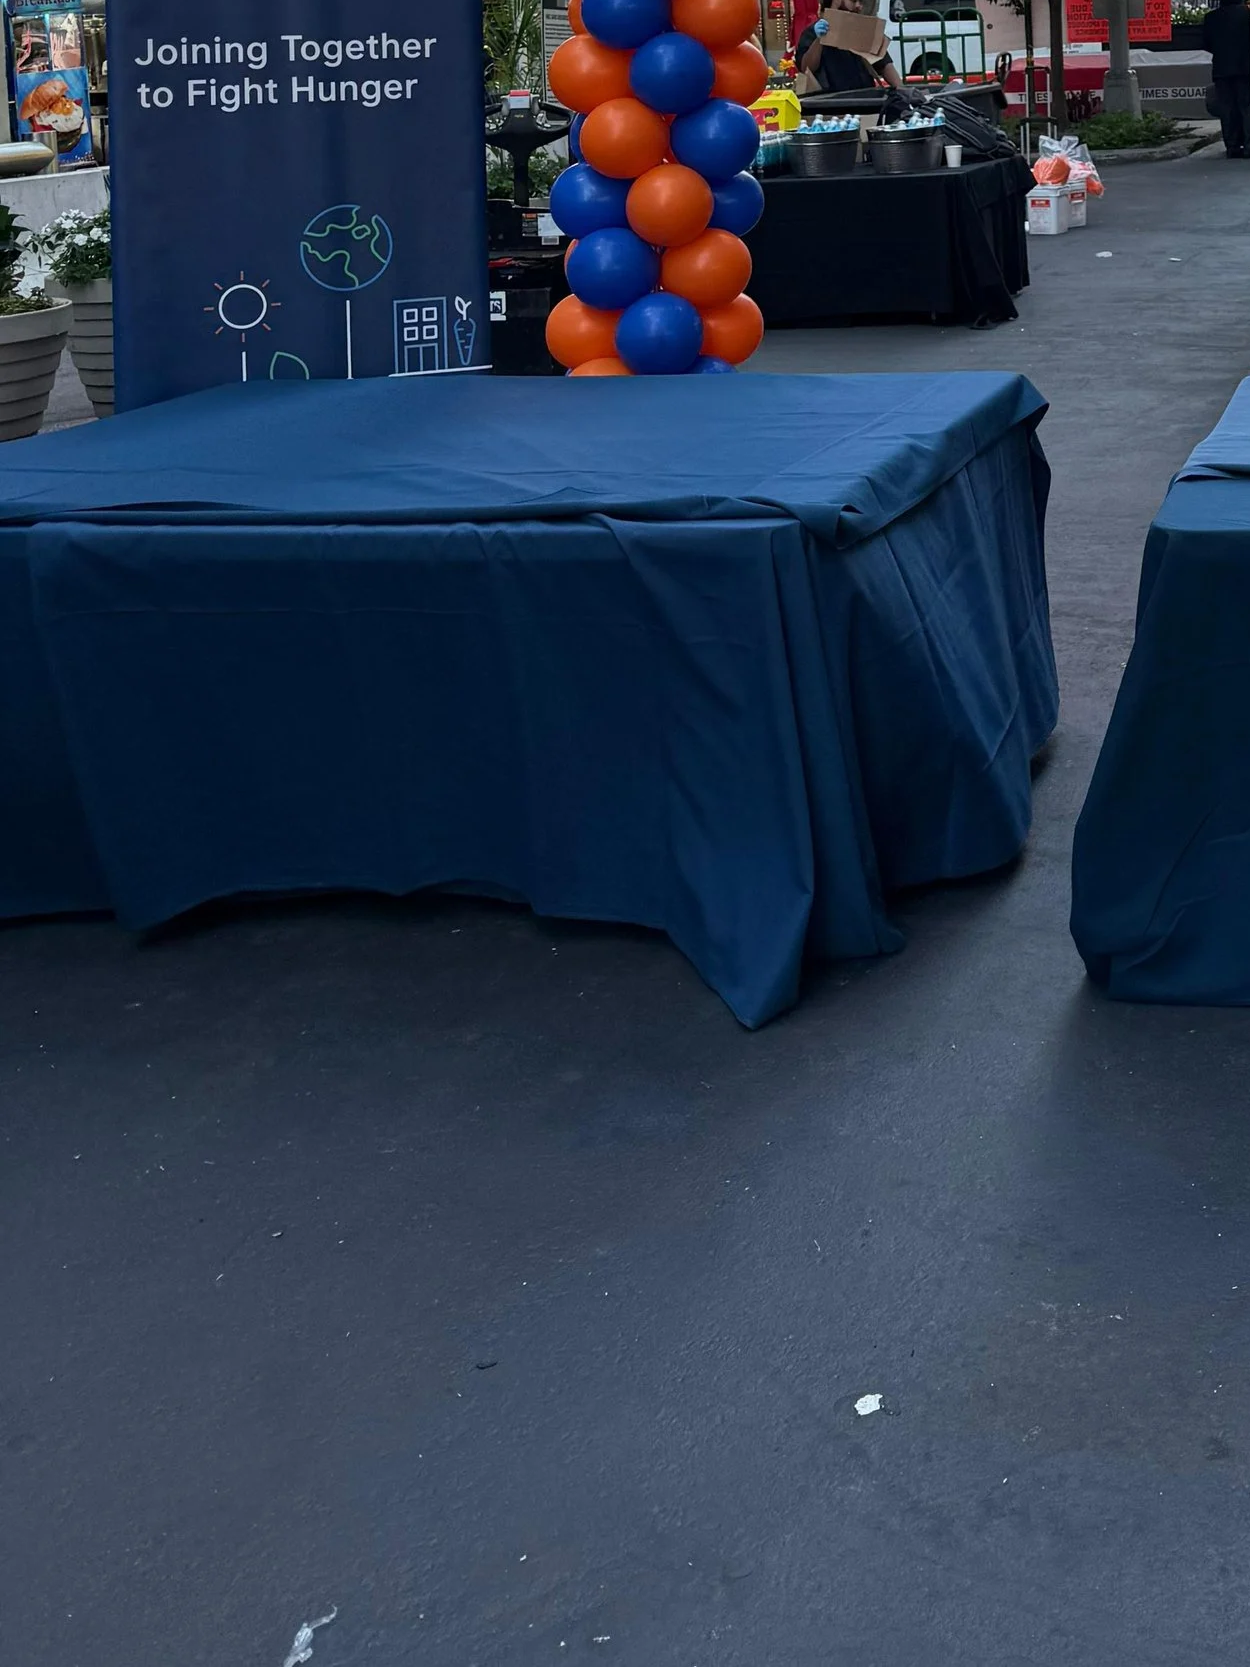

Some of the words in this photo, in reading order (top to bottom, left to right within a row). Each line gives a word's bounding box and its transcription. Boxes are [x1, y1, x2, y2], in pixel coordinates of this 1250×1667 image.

[134, 36, 268, 70] Joining
[280, 32, 437, 68] Together
[136, 83, 174, 108] to
[187, 77, 278, 113] Fight
[291, 75, 418, 109] Hunger
